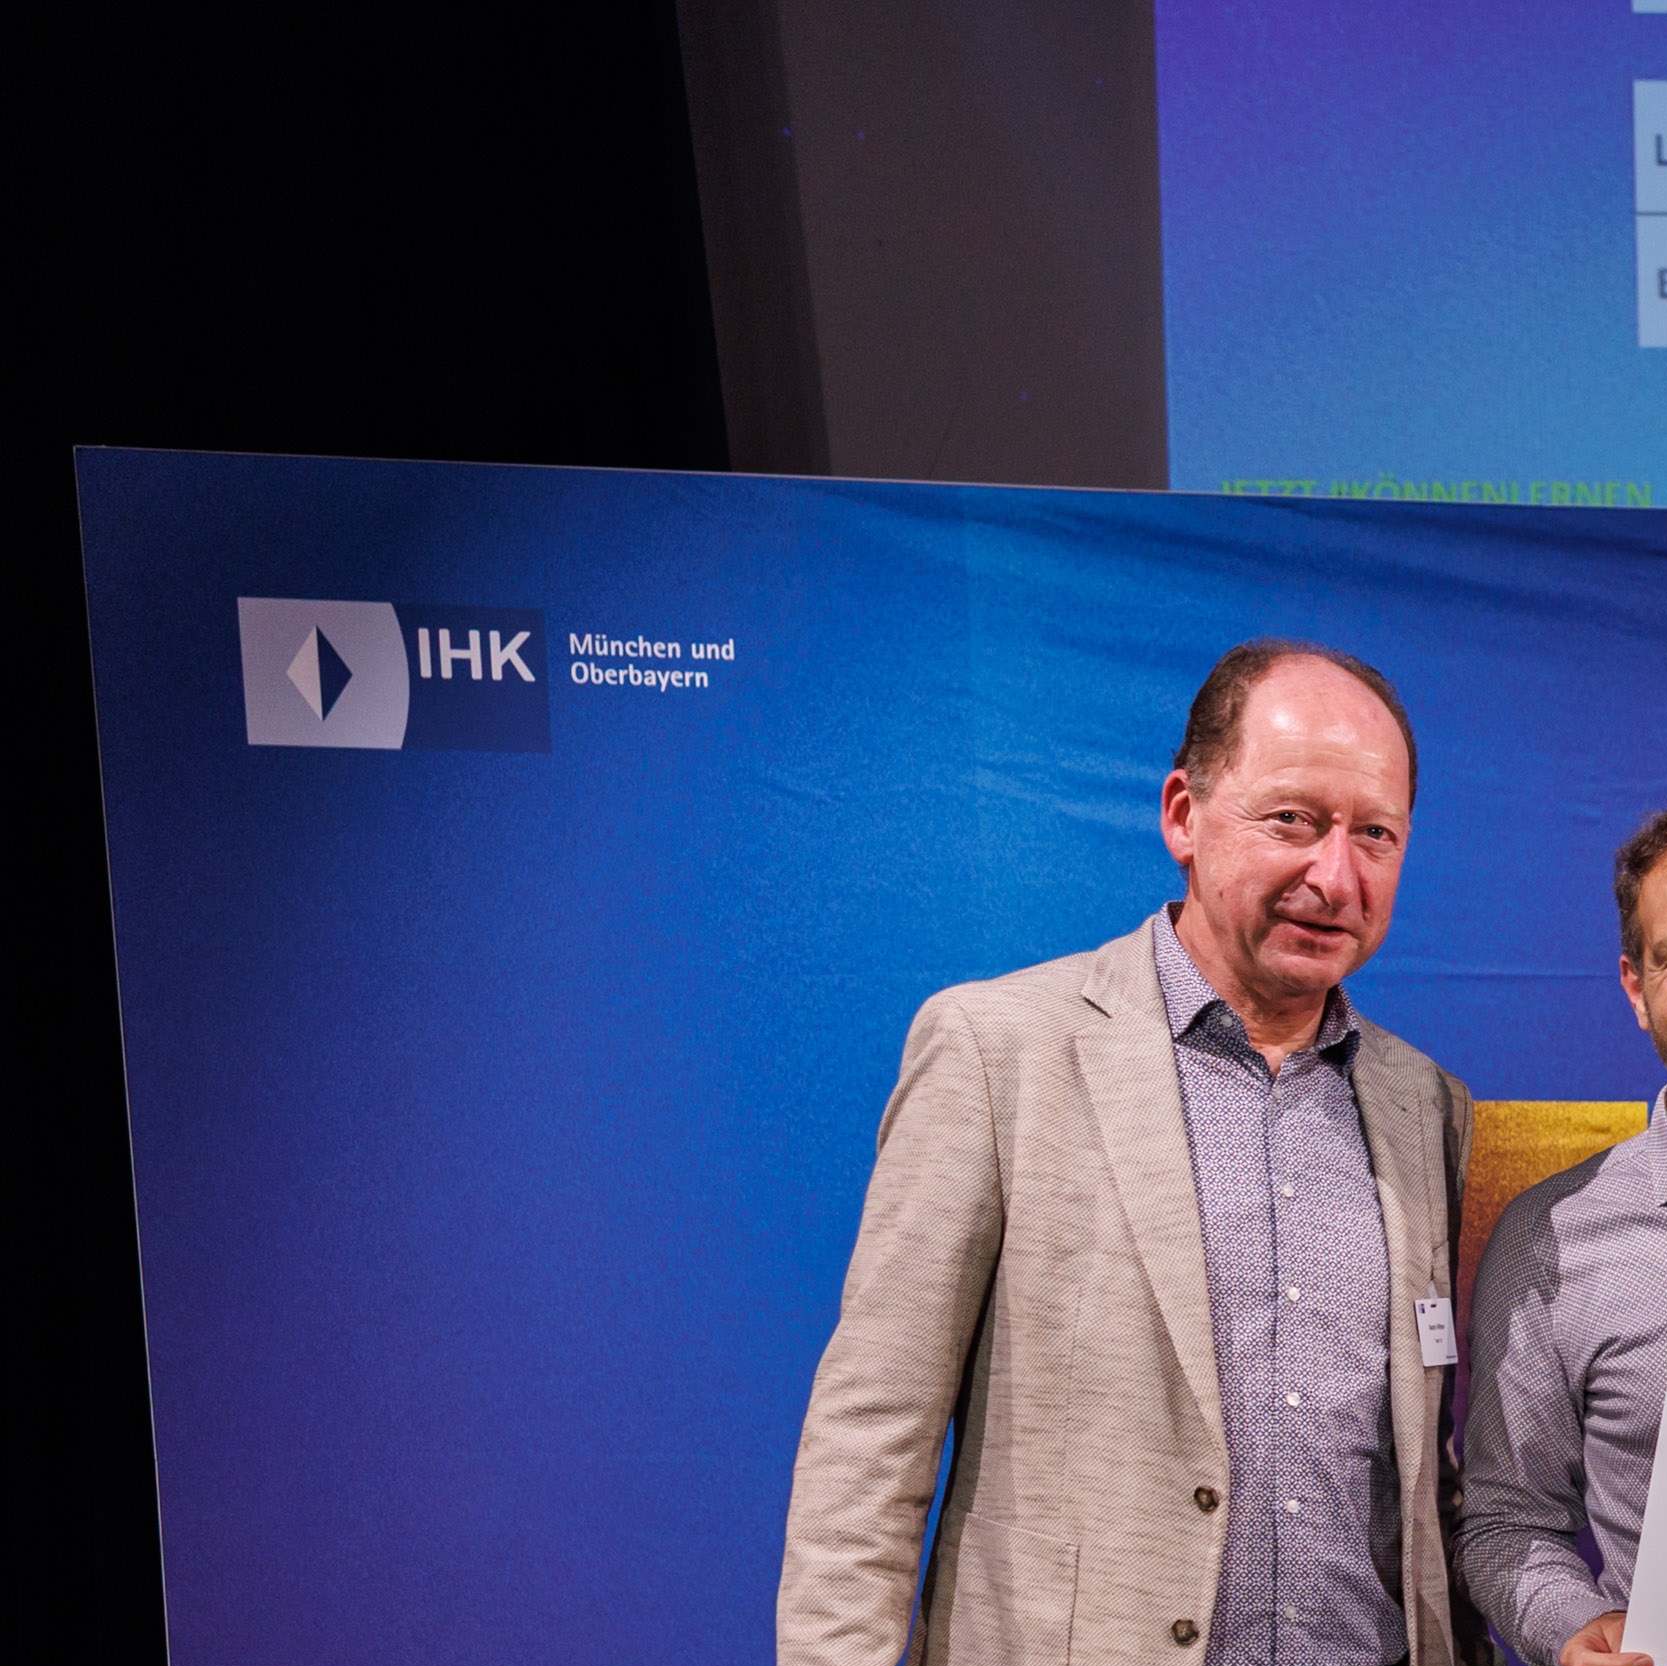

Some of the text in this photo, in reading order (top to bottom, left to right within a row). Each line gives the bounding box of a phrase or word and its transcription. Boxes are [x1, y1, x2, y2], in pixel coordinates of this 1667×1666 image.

[418, 628, 536, 682] IHK
[569, 633, 735, 660] München und
[571, 662, 709, 692] Oberbayern
